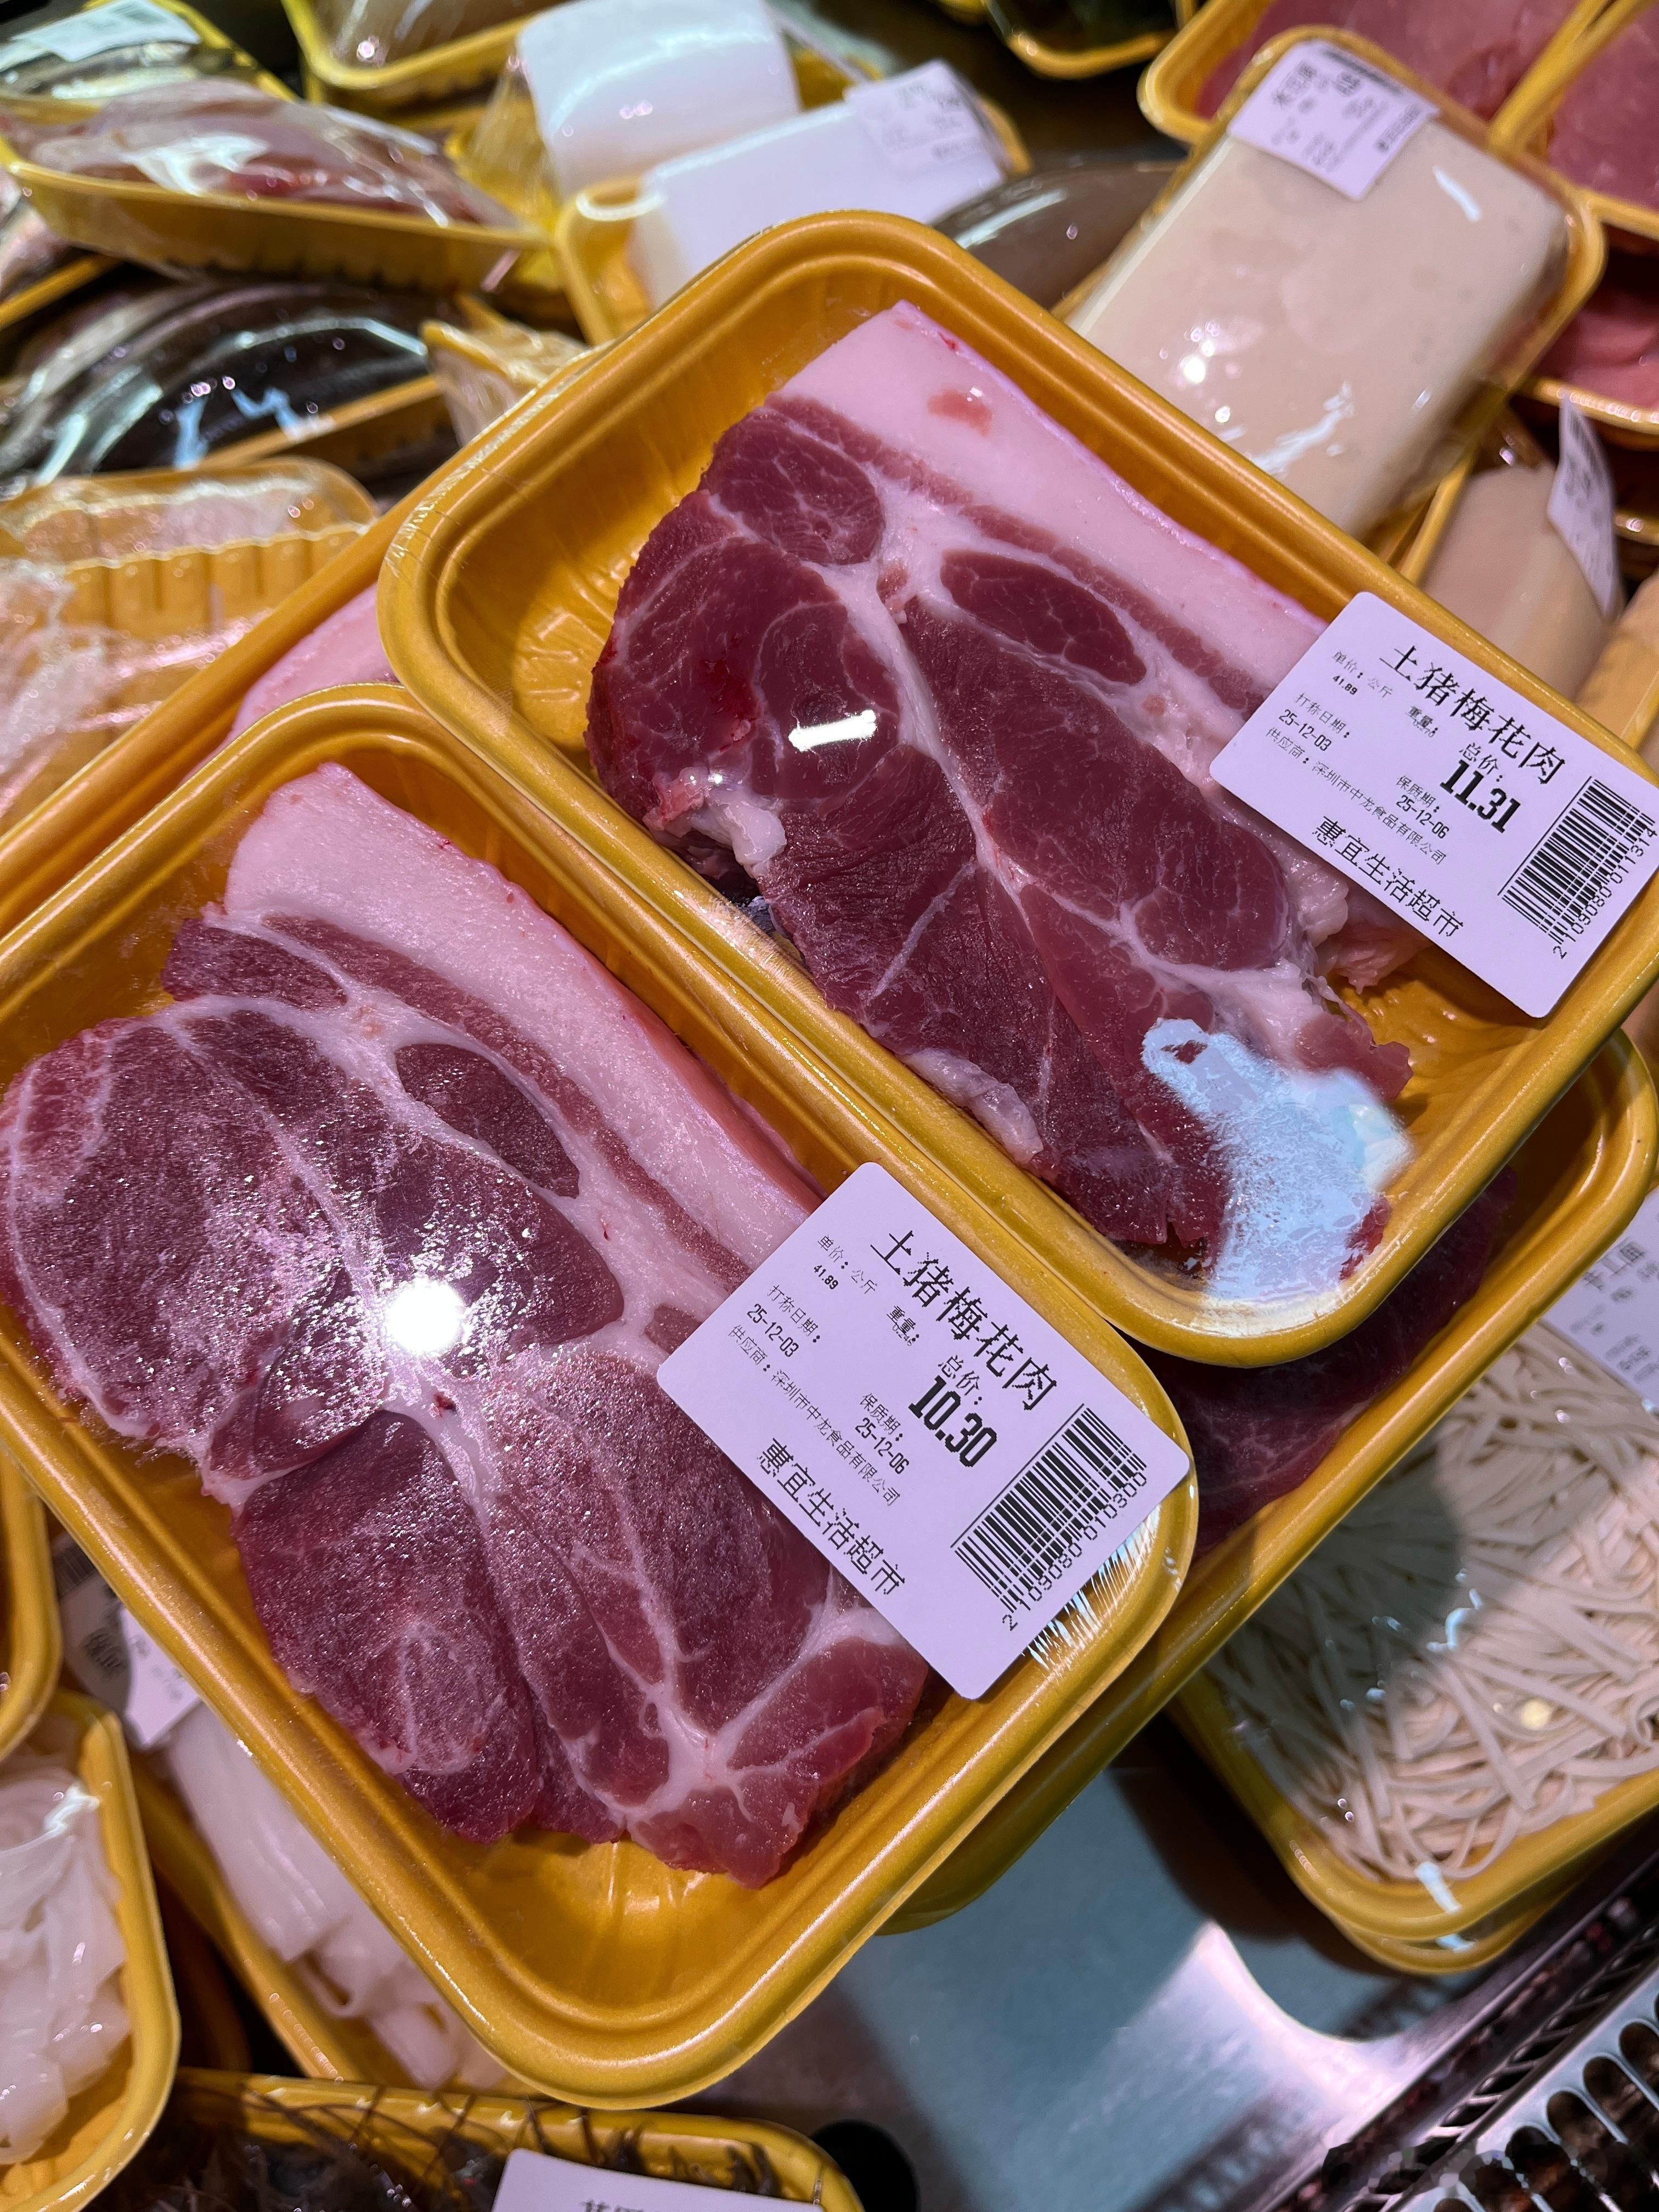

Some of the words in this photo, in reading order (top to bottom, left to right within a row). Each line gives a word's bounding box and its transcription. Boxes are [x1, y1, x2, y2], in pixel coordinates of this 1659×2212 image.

[1333, 675, 1358, 695] 41.89
[1279, 709, 1332, 752] 25-12-03
[1379, 645, 1566, 785] 土猪梅花肉
[1459, 742, 1503, 782] 总价：
[1396, 795, 1450, 839] 25-12-06
[1440, 759, 1521, 833] 11.31
[1312, 815, 1464, 937] 惠宜生活超市
[814, 1265, 839, 1290] 41.89
[747, 1304, 799, 1357] 25-12-03
[870, 1230, 1057, 1410] 土猪梅花肉
[938, 1355, 983, 1405] 总价：
[855, 1417, 910, 1474] 25-12-06
[908, 1375, 997, 1467] 10.30
[757, 1437, 905, 1595] 惠宜生活超市
